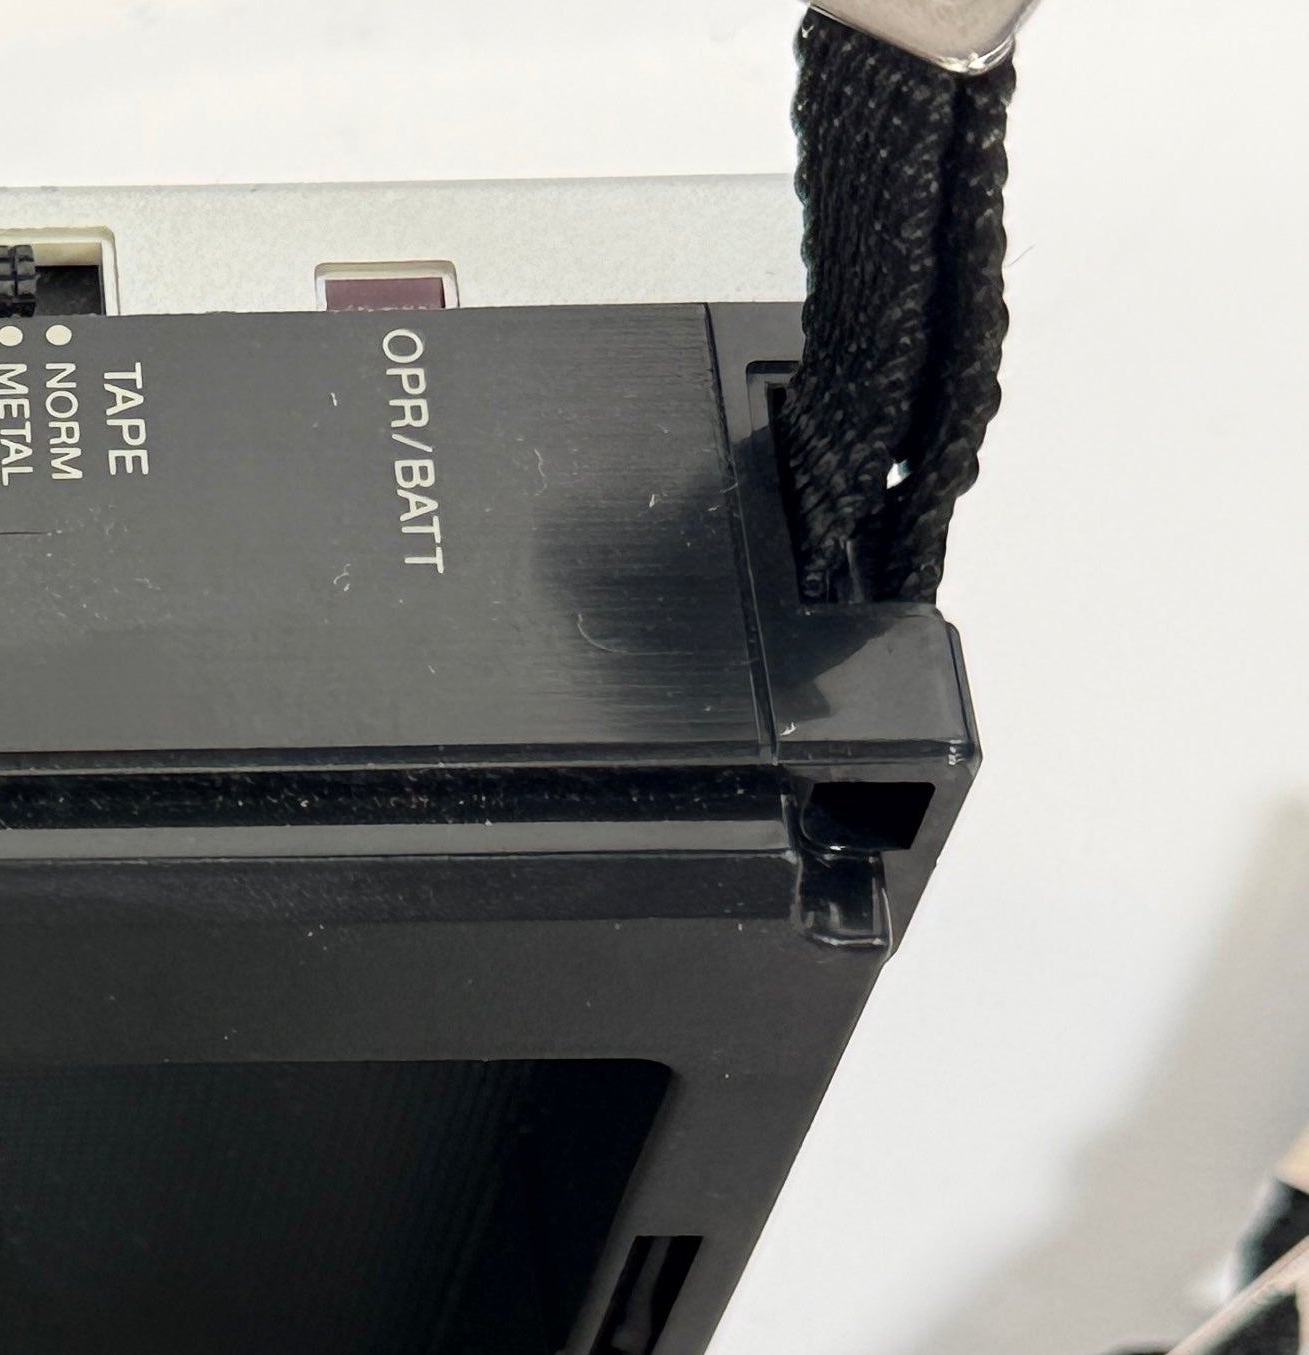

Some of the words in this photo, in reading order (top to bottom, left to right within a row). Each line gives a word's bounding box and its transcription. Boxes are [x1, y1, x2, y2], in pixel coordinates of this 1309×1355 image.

[45, 362, 83, 480] NORM
[103, 362, 149, 475] TAPE
[382, 328, 445, 574] OPR/BATT
